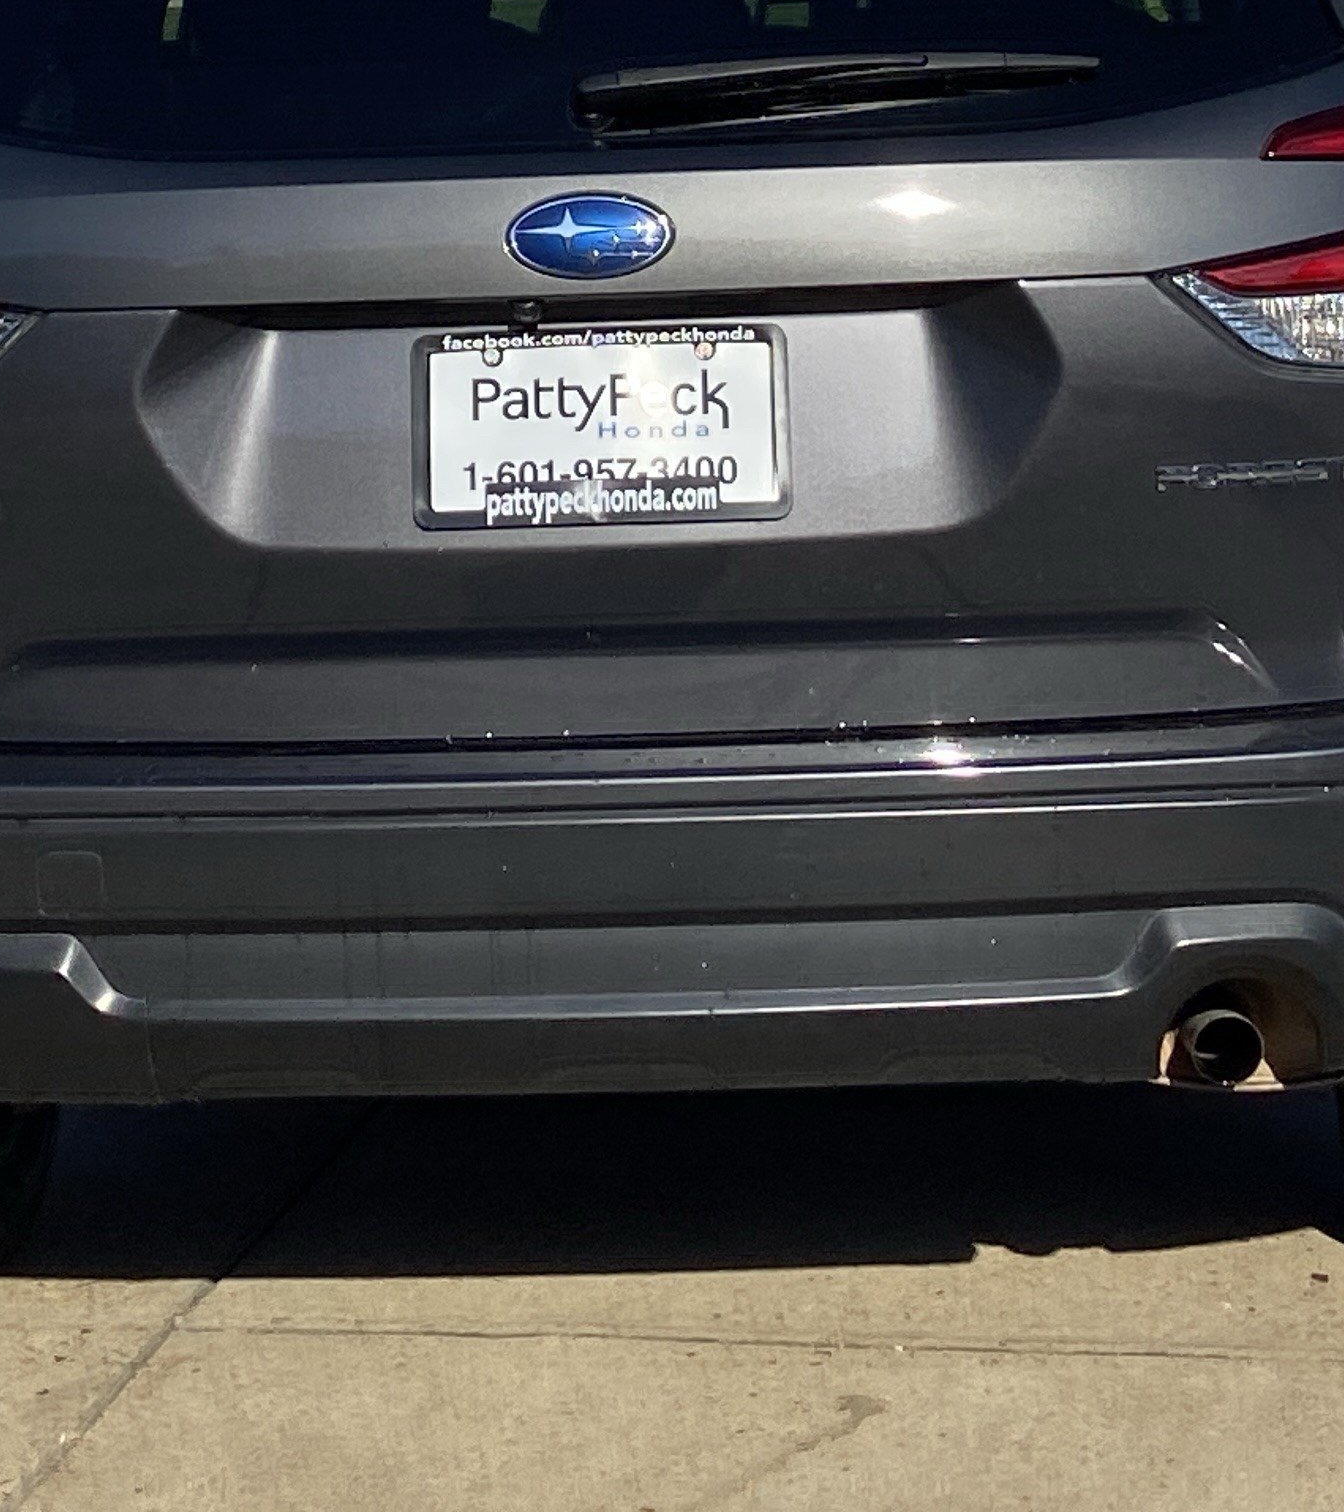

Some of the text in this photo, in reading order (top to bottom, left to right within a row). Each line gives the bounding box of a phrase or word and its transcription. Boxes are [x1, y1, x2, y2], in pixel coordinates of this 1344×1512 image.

[442, 326, 755, 351] facebook.com/pattypeckhonda
[471, 369, 730, 432] PattyPck
[598, 420, 710, 439] Honda
[463, 456, 737, 491] 1-601-957-3400
